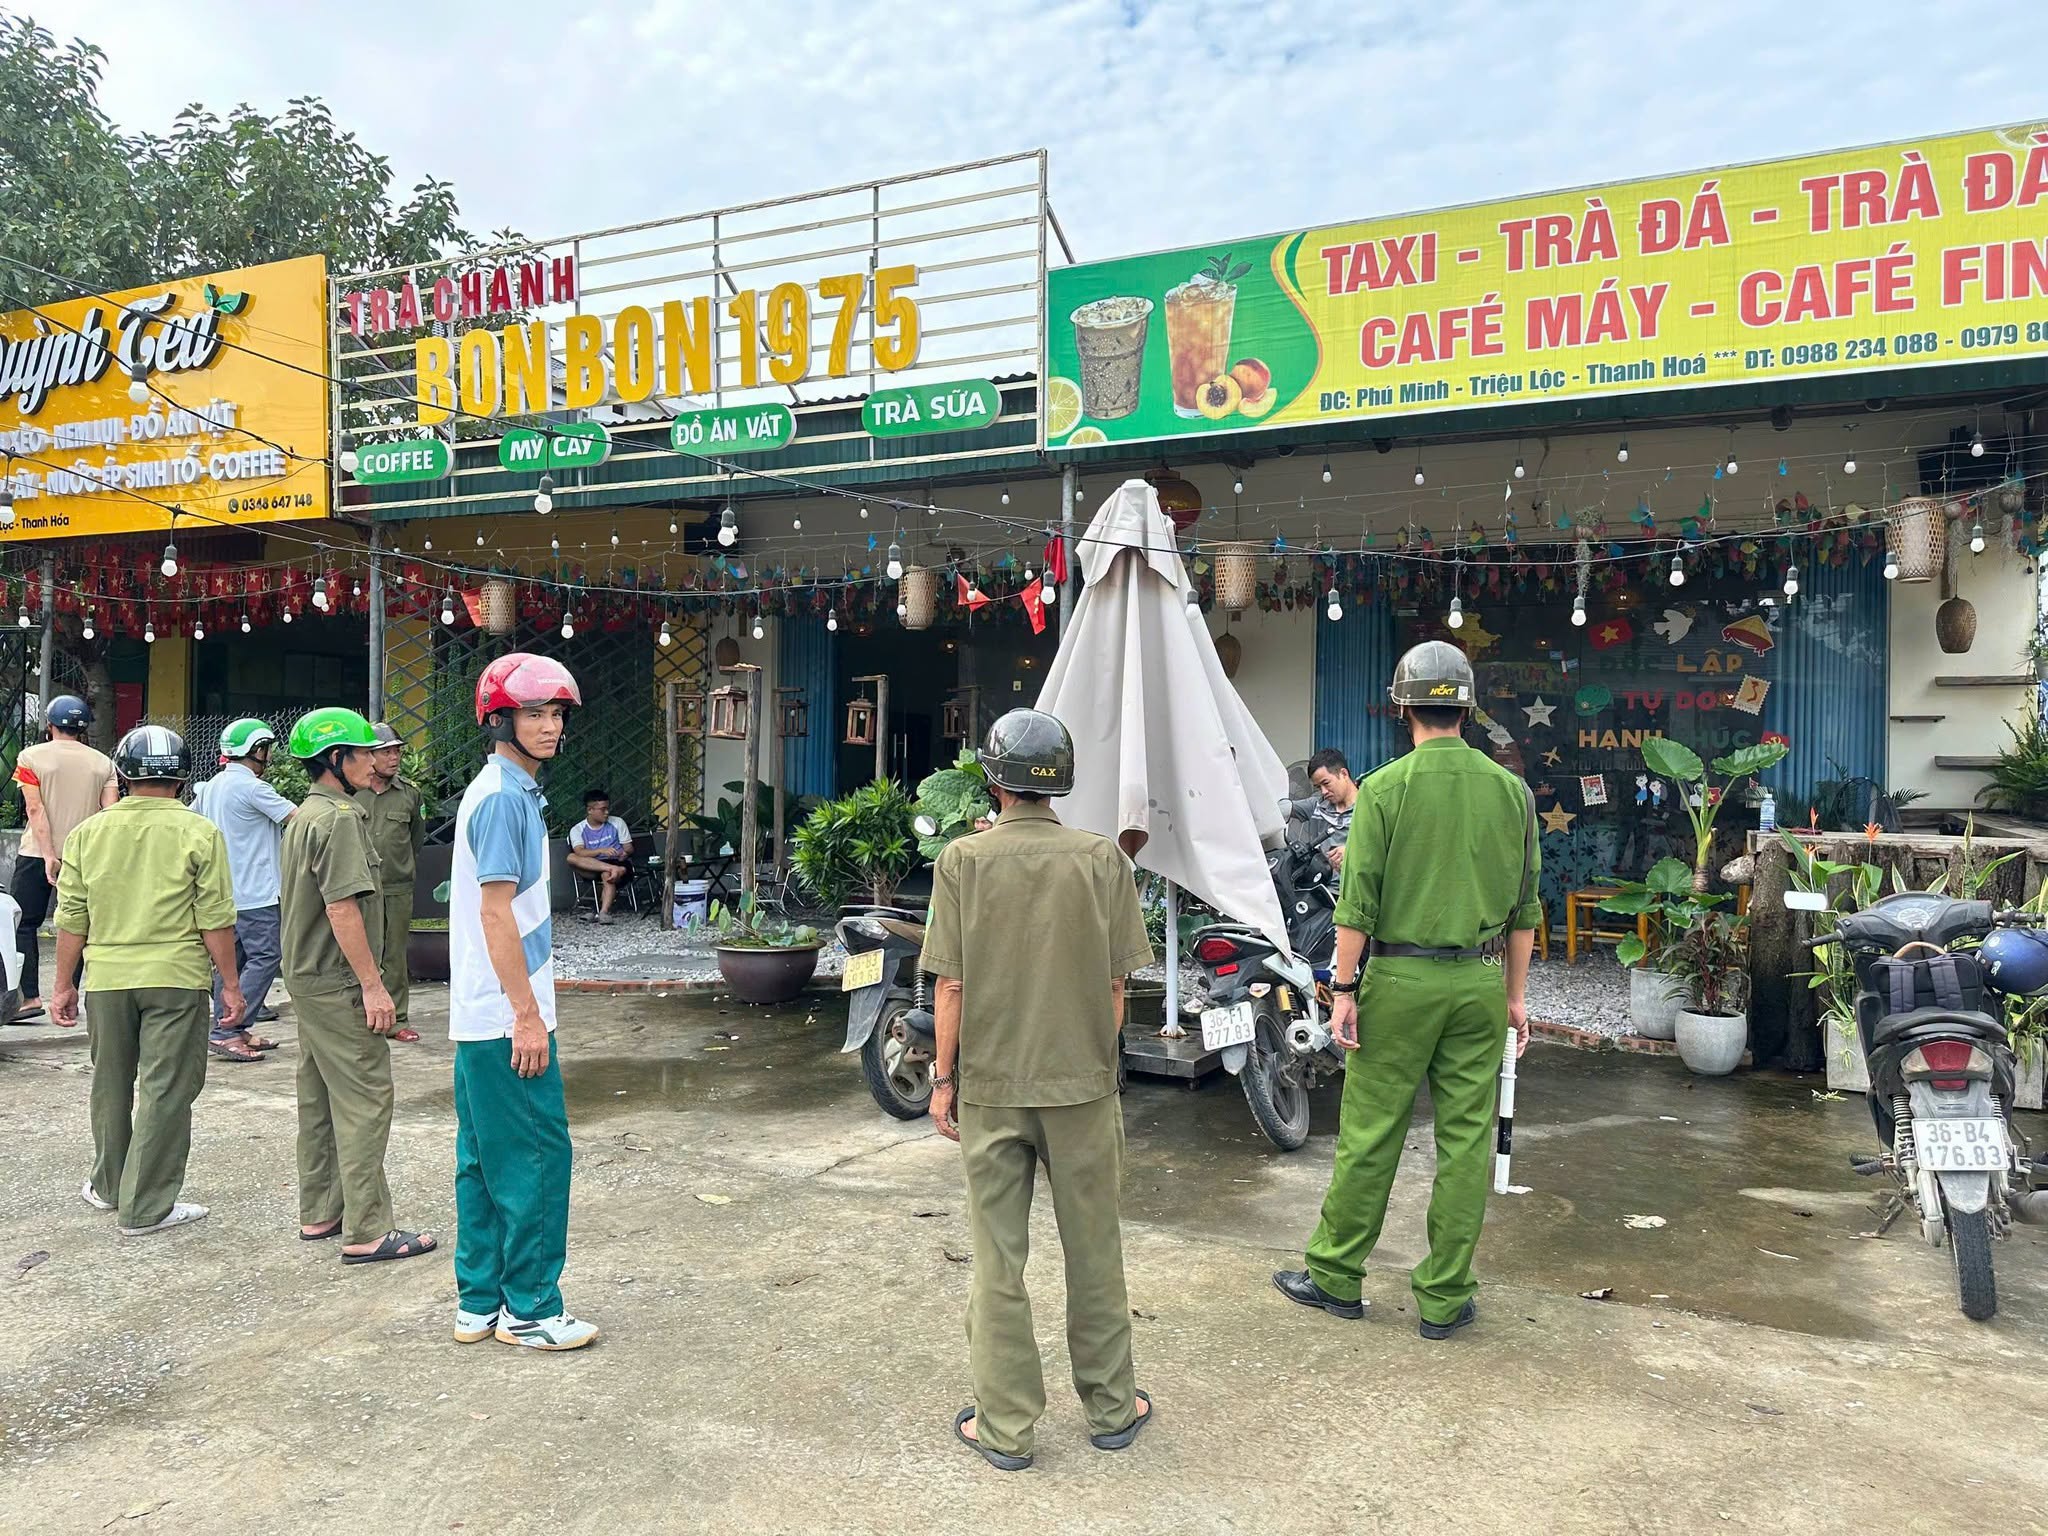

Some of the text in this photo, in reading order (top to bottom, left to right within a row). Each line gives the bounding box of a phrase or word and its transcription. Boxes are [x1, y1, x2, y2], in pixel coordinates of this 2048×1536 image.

[1322, 233, 1436, 295] TAXI
[1500, 198, 1619, 271] TRÀ
[1638, 181, 1730, 254] ĐÁ
[1801, 151, 1941, 232] TRÀ
[346, 256, 579, 337] TRÀ CHANH
[1361, 294, 1504, 367] CAFÉ
[1527, 278, 1668, 350] MÁY
[1740, 243, 1915, 327] CAFÉ
[728, 264, 922, 388] 1975
[0, 293, 224, 415] uỳnh Tea
[1320, 391, 1350, 411] ĐC:
[1357, 386, 1393, 408] Phú
[1400, 380, 1449, 403] Minh
[1469, 373, 1522, 397] Triệu
[1530, 369, 1565, 393] Lộc
[1587, 359, 1655, 384] Thanh
[1663, 353, 1706, 378] Hoá
[1745, 349, 1775, 370] ĐT:
[1782, 343, 1838, 366] 0988
[1846, 338, 1887, 360] 234
[1895, 333, 1938, 356] 088
[1962, 324, 2018, 349] 0979
[54, 419, 93, 449] NEM
[131, 397, 165, 440] ĐỒ
[872, 388, 987, 426] TRÀ SỮA
[553, 433, 594, 457] CAY
[676, 411, 783, 446] ĐỒ ĂN VẶT
[125, 460, 171, 489] SINH
[171, 442, 201, 484] TỐ
[208, 448, 287, 480] COFFEE
[363, 449, 434, 474] COFFEE
[242, 493, 313, 512] 0348 647 148
[21, 516, 48, 530] Thanh
[50, 512, 70, 527] Hóa
[1676, 649, 1743, 676] LẬP
[1622, 687, 1718, 716] TỰ DO
[1031, 767, 1057, 777] CAX
[1207, 1023, 1251, 1048] 277.83
[1925, 1145, 2001, 1167] 176.83
